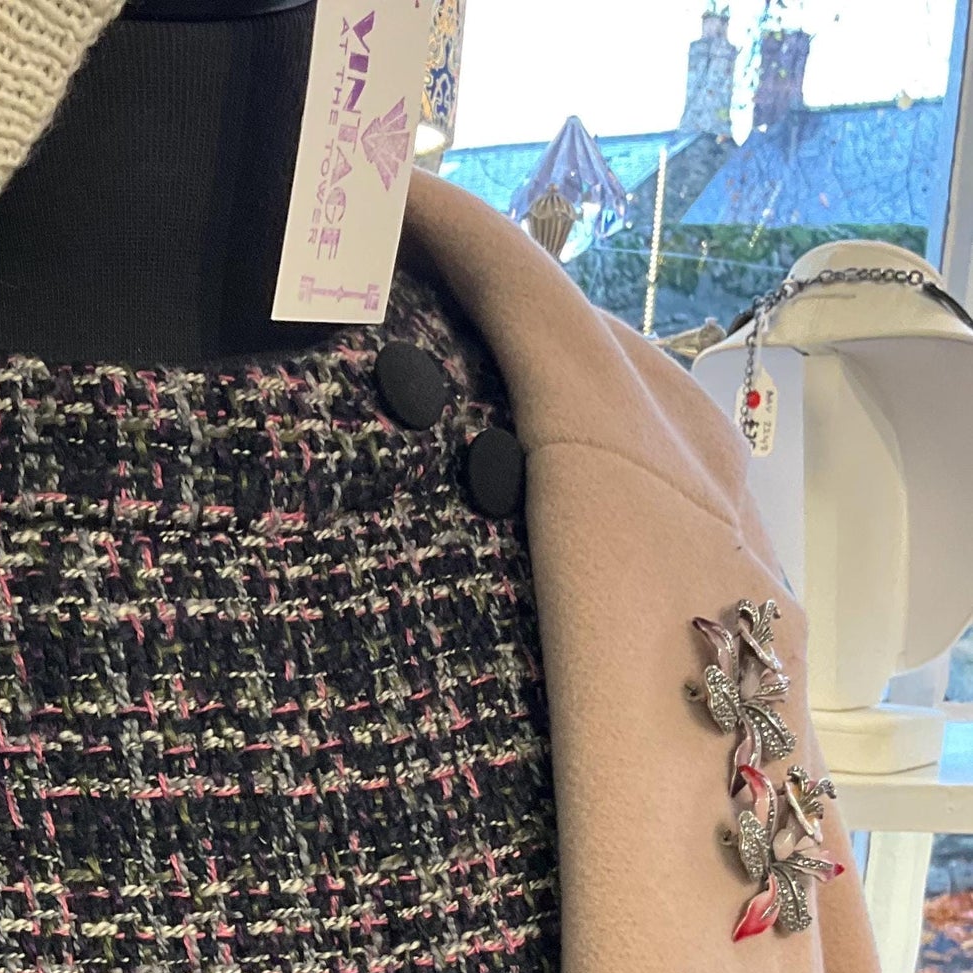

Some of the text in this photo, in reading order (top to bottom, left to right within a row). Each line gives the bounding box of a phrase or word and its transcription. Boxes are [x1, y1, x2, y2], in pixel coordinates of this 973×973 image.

[308, 17, 350, 244] AT THE TOWER
[317, 10, 375, 260] VINTAGE
